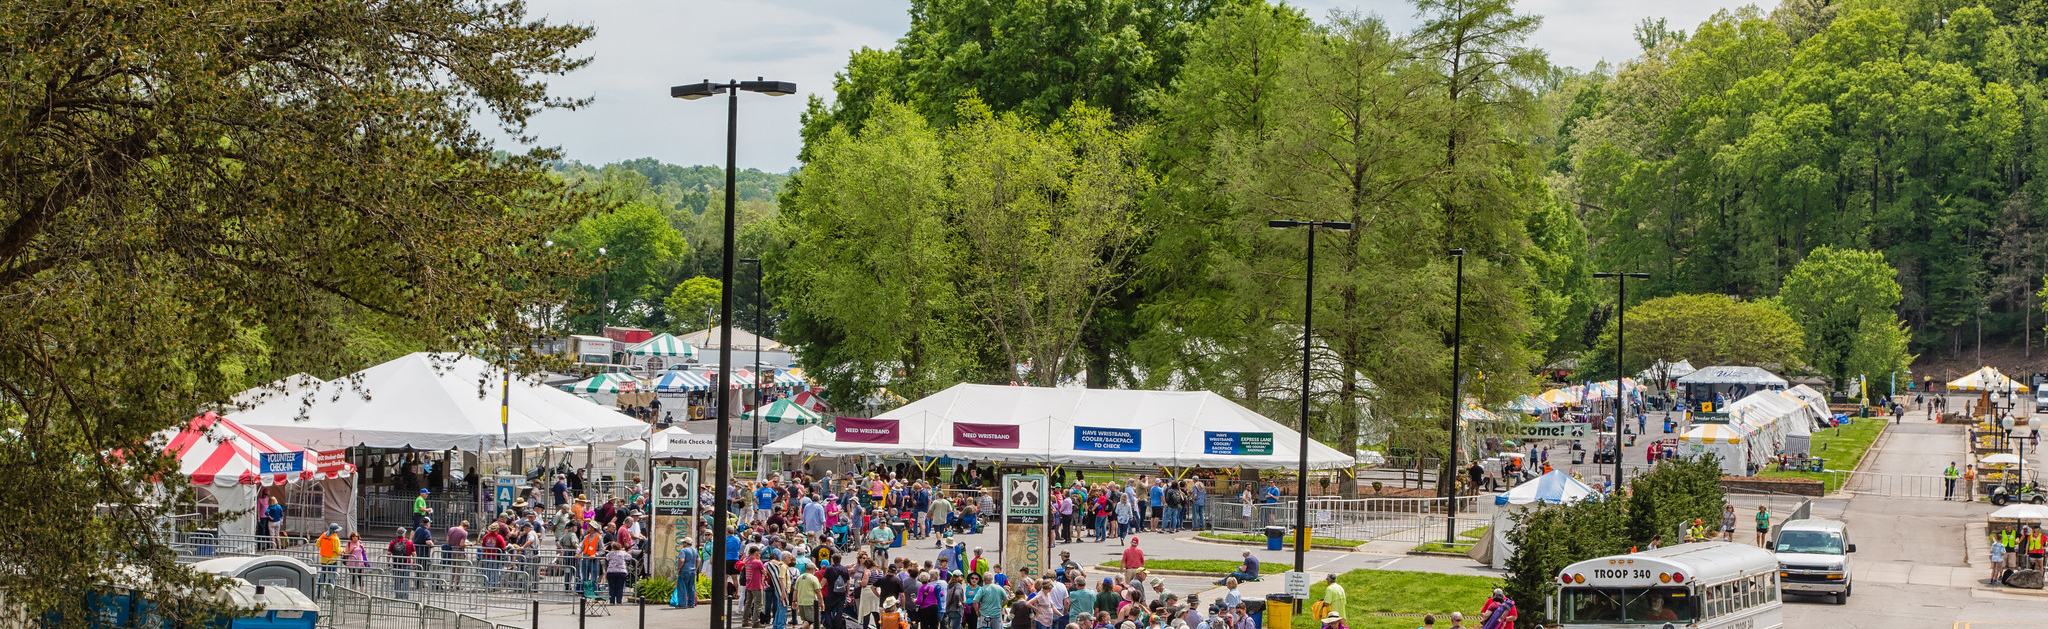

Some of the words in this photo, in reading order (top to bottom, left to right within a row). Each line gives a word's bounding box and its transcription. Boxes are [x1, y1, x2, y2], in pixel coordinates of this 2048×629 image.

[1492, 422, 1565, 436] Welcome!
[267, 453, 296, 462] VOLUNTEER
[270, 462, 292, 472] CHECK-IN
[1594, 569, 1629, 579] TROOP
[1633, 570, 1651, 579] 340
